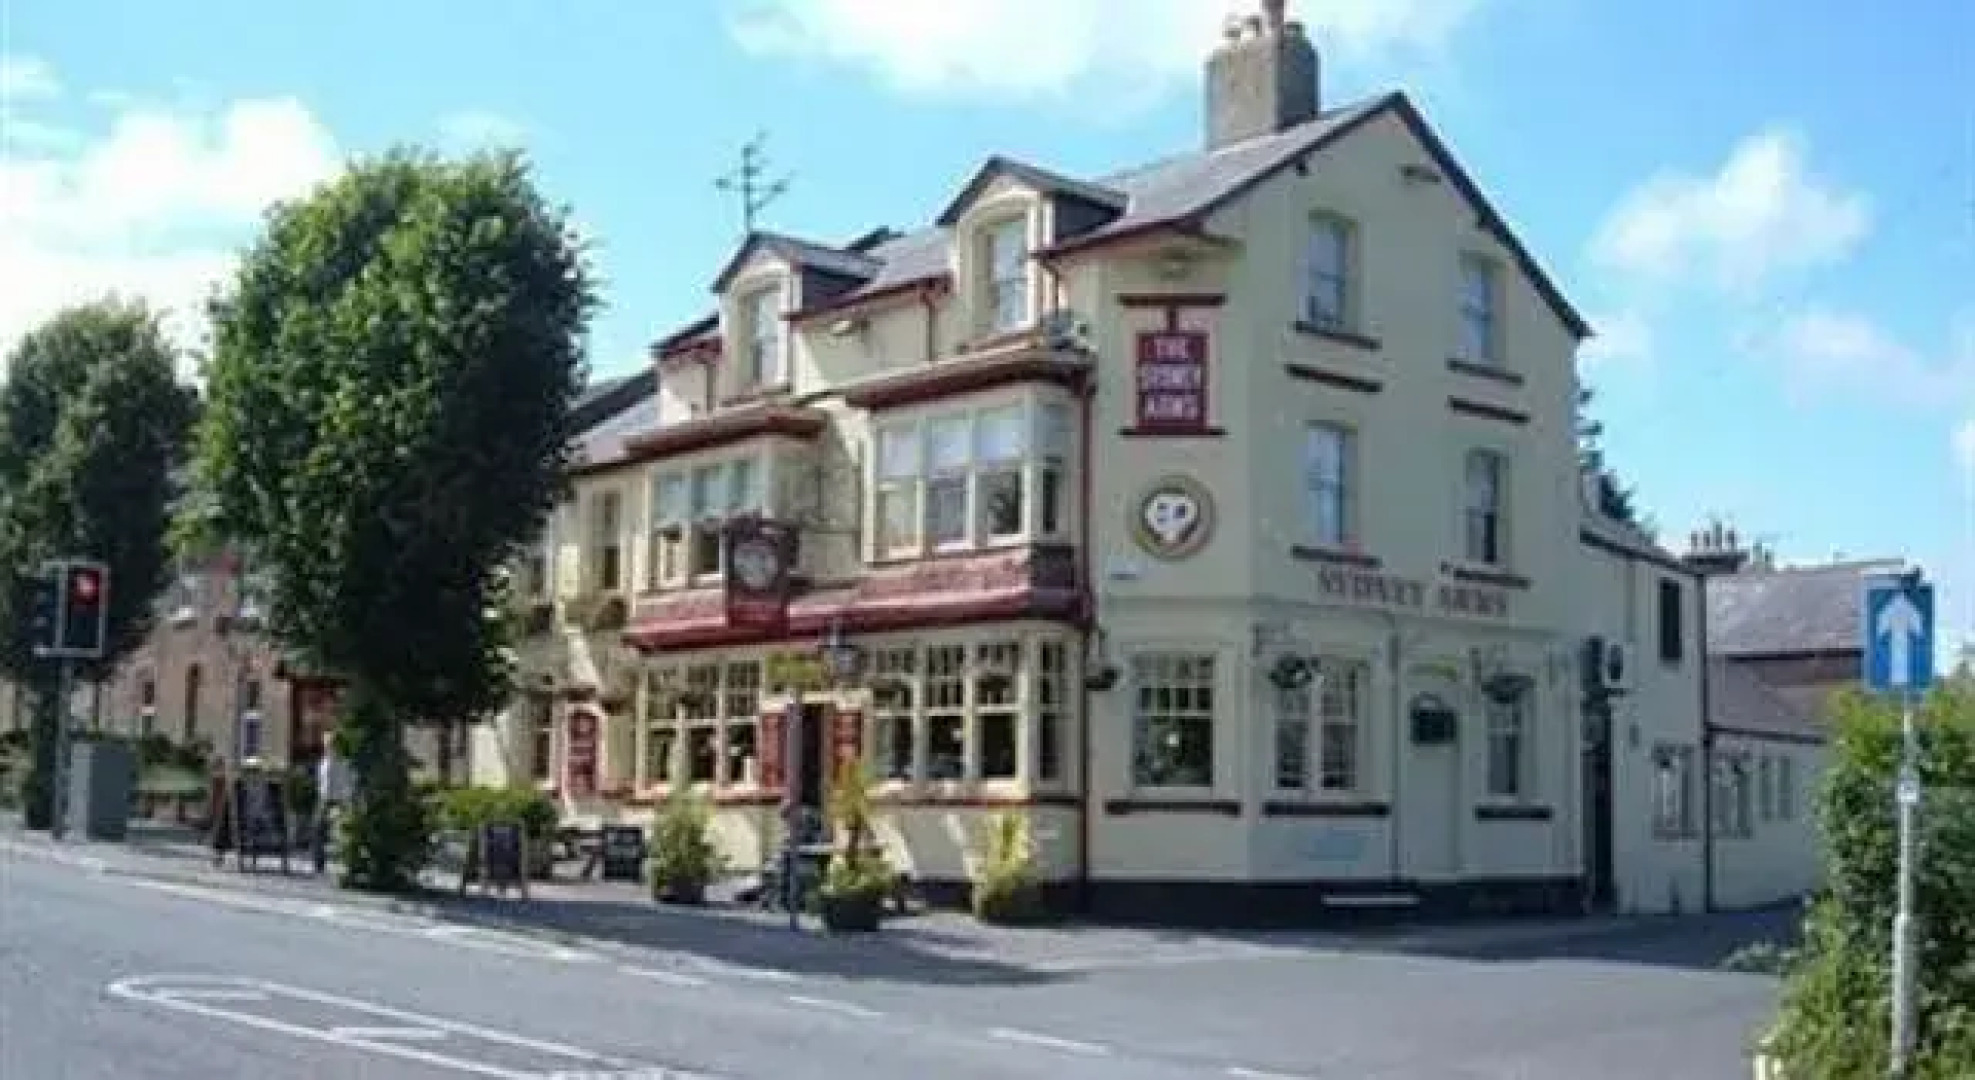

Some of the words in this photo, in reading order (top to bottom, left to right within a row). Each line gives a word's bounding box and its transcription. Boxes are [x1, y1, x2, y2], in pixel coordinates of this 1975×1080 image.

[1153, 338, 1189, 360] THE
[1138, 366, 1203, 390] SYDNEY
[1144, 394, 1199, 420] ARMS
[1317, 564, 1427, 608] SYDNEY
[1437, 584, 1509, 619] ARMS
